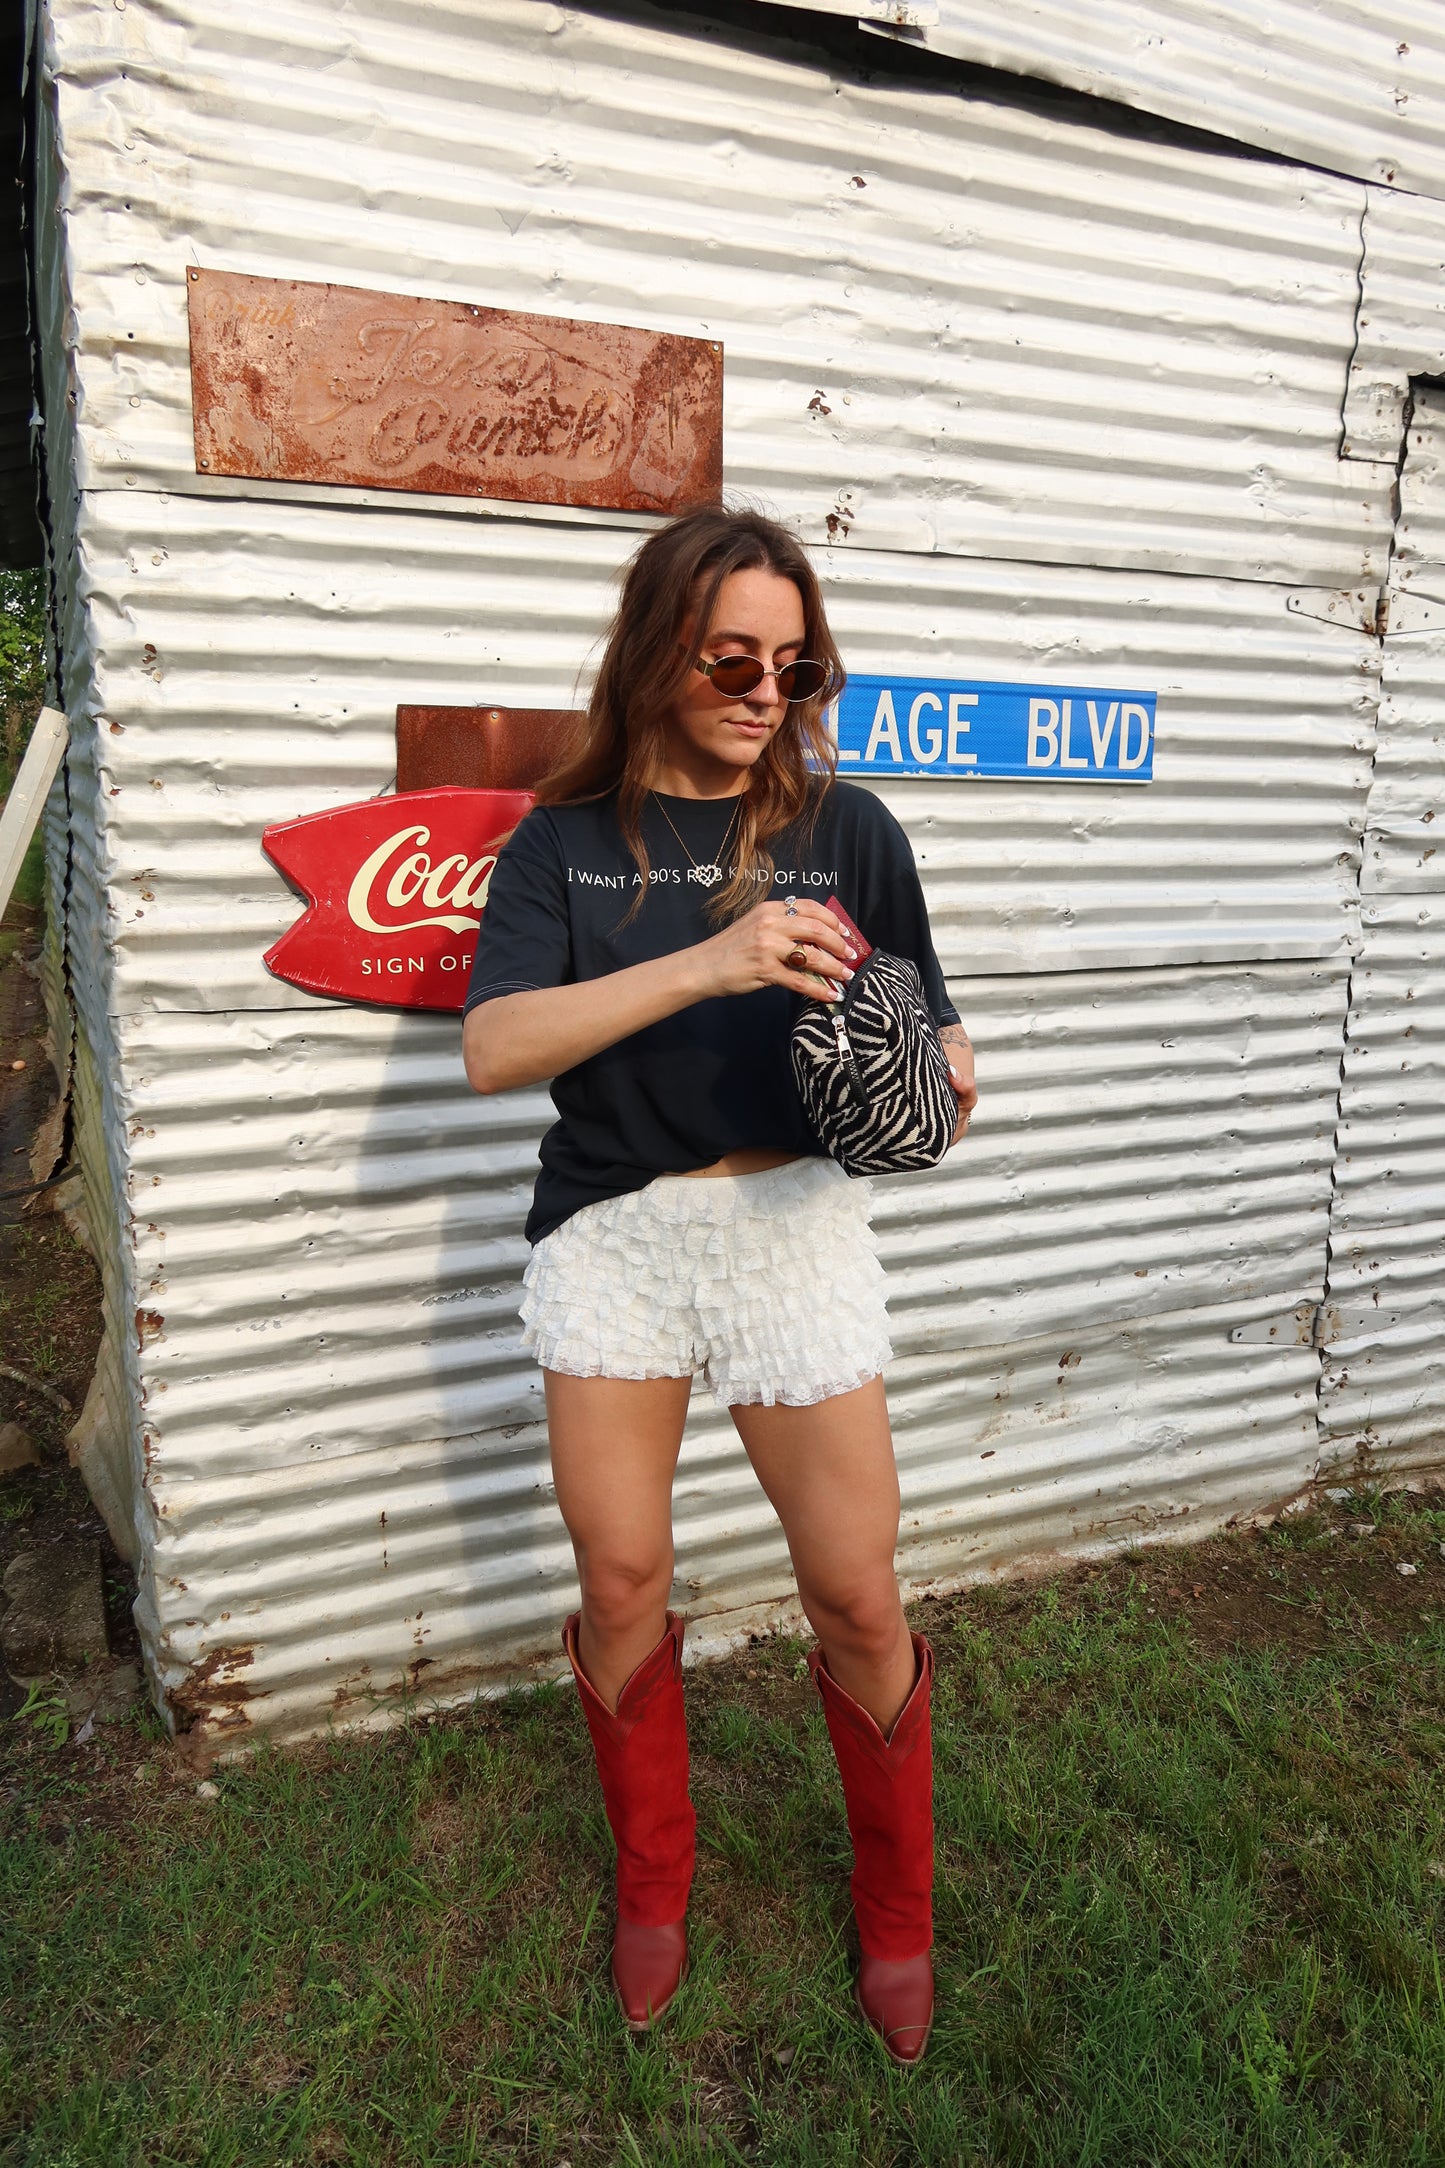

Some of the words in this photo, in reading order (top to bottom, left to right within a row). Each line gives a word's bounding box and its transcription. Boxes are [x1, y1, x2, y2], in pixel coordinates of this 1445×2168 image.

[329, 317, 573, 405] Texas
[366, 387, 625, 468] Punch
[800, 689, 979, 764] LAGE
[1027, 697, 1149, 770] BLVD
[347, 825, 498, 934] Coca
[567, 867, 573, 882] I
[577, 869, 626, 889] WANT
[632, 872, 644, 886] A
[648, 868, 681, 884] 90'S
[728, 866, 769, 882] KND
[774, 870, 797, 884] OF
[361, 956, 425, 975] SIGN
[439, 954, 472, 971] OF
